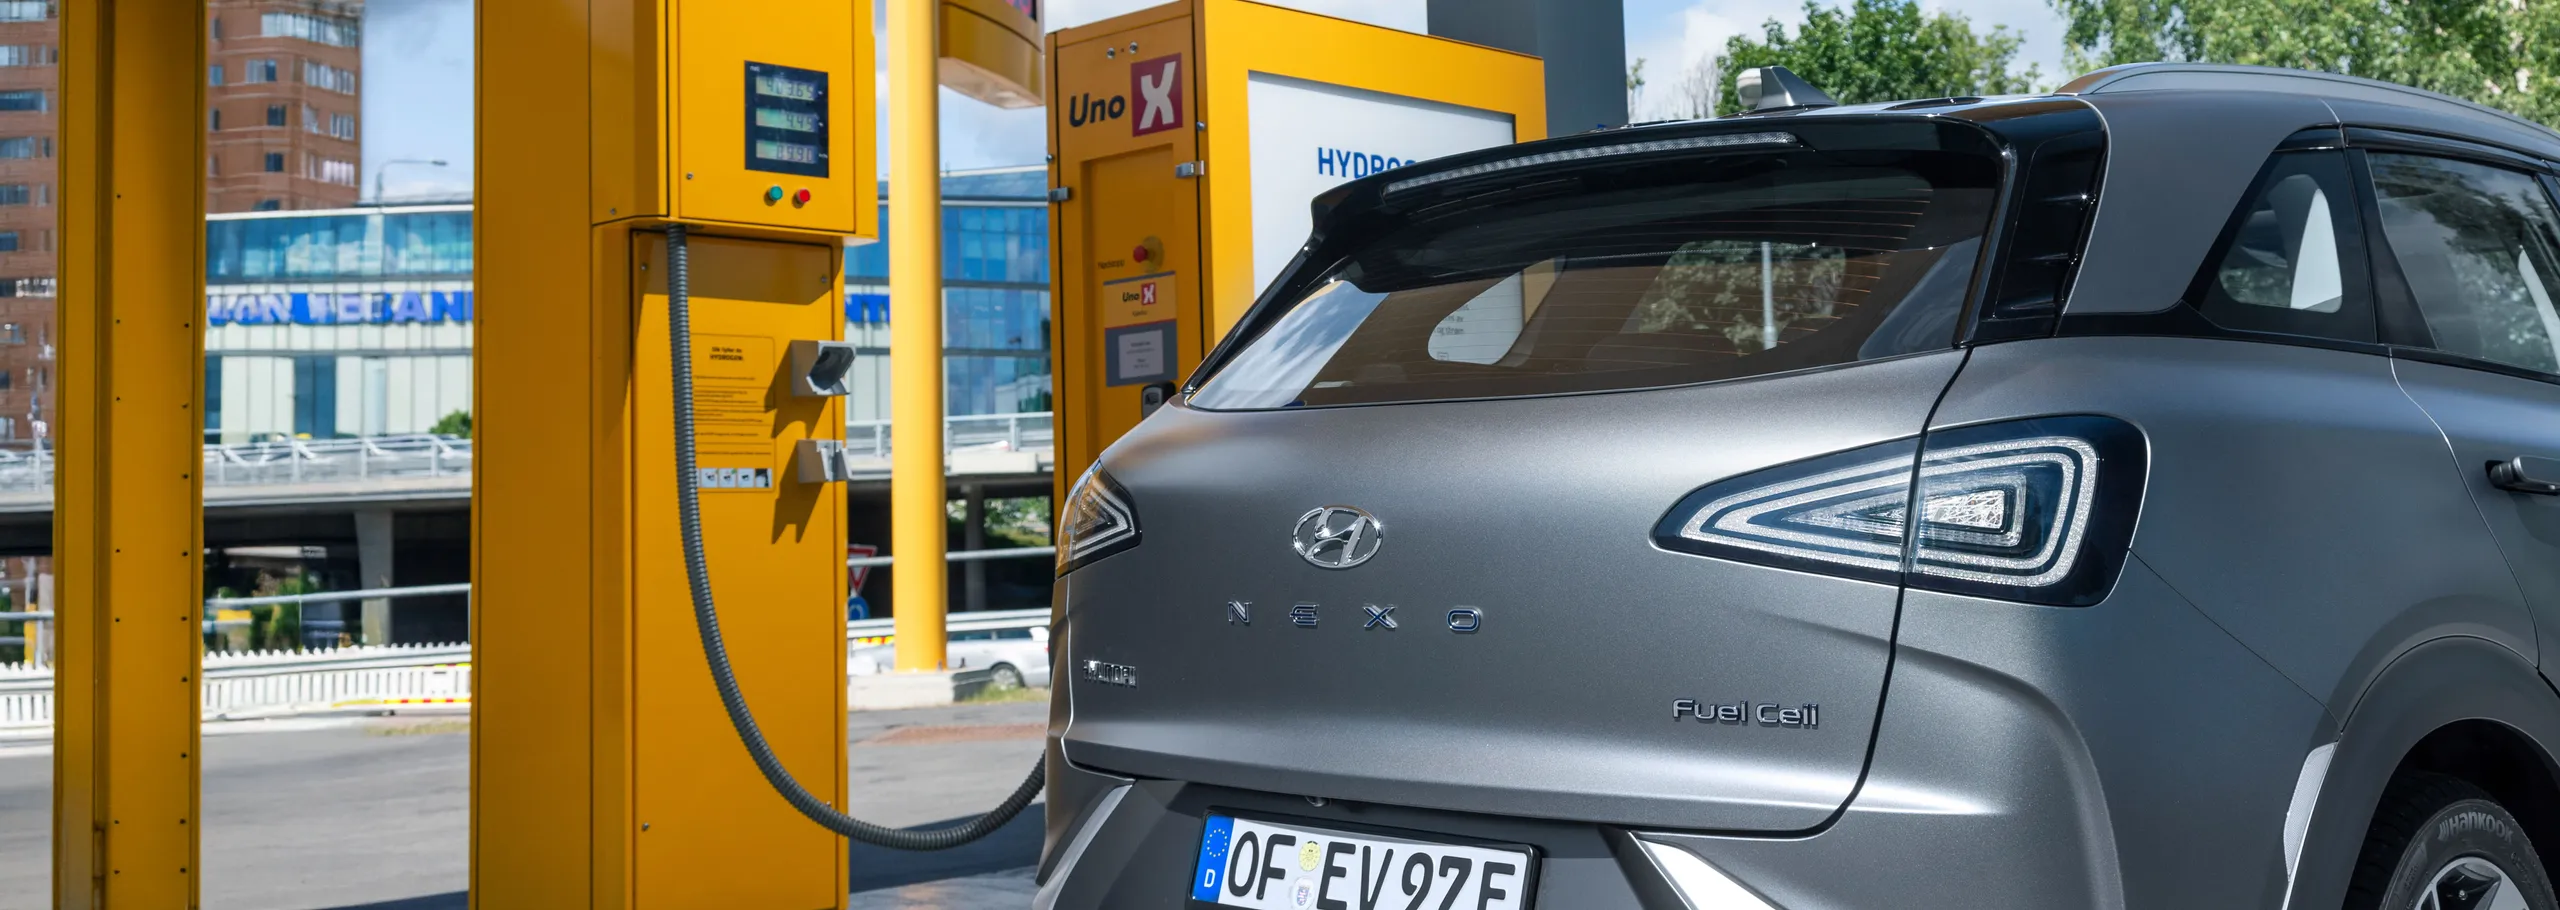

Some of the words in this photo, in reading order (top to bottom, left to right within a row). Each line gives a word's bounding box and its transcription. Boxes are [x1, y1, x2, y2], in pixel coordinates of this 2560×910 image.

[1069, 92, 1125, 127] Uno
[1139, 60, 1177, 130] X
[1122, 291, 1140, 302] Uno
[1143, 283, 1155, 305] X
[1227, 600, 1482, 632] NEXO
[1672, 698, 1748, 726] Fuel
[1755, 702, 1818, 730] Cell
[1204, 868, 1216, 888] D
[1227, 830, 1297, 901] OF
